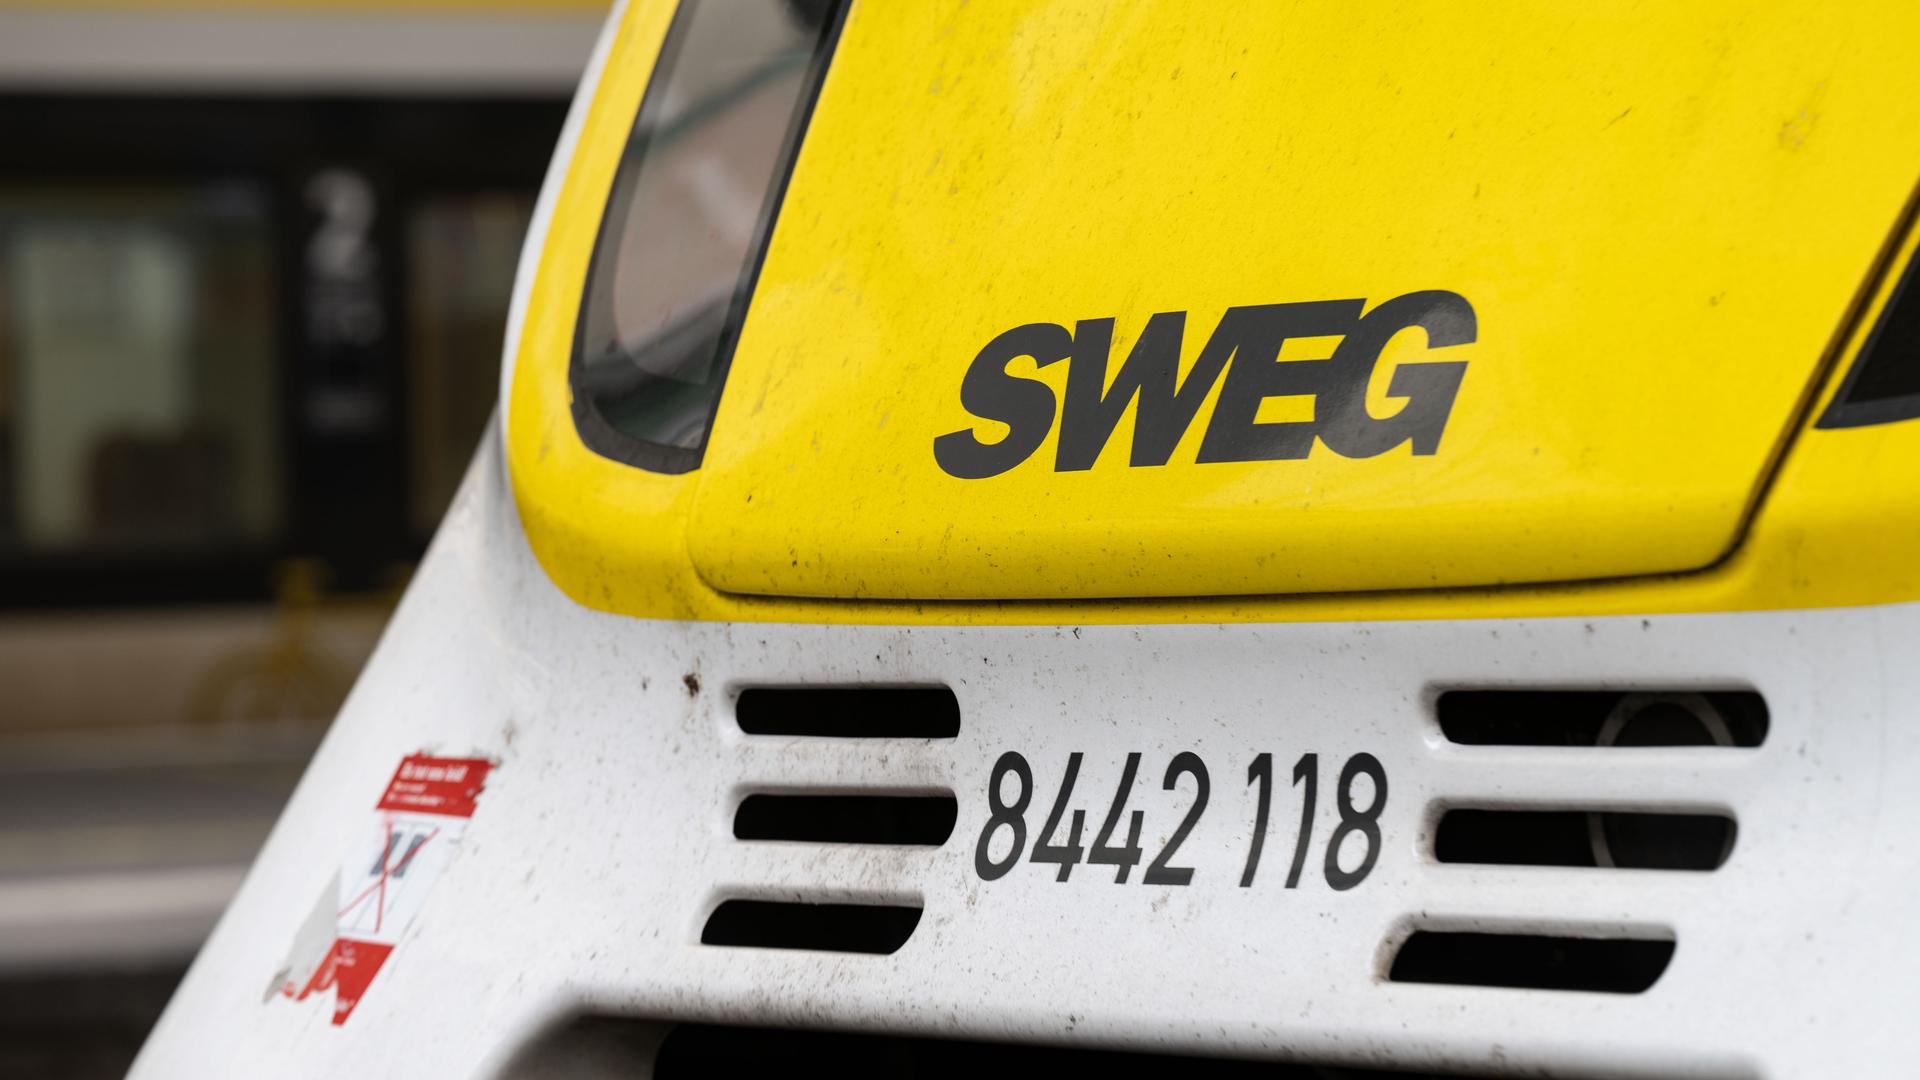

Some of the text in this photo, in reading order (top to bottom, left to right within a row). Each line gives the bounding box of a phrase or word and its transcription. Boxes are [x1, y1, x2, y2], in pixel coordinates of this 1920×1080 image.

[933, 289, 1478, 479] SWEG
[974, 750, 1389, 892] 8442 118
